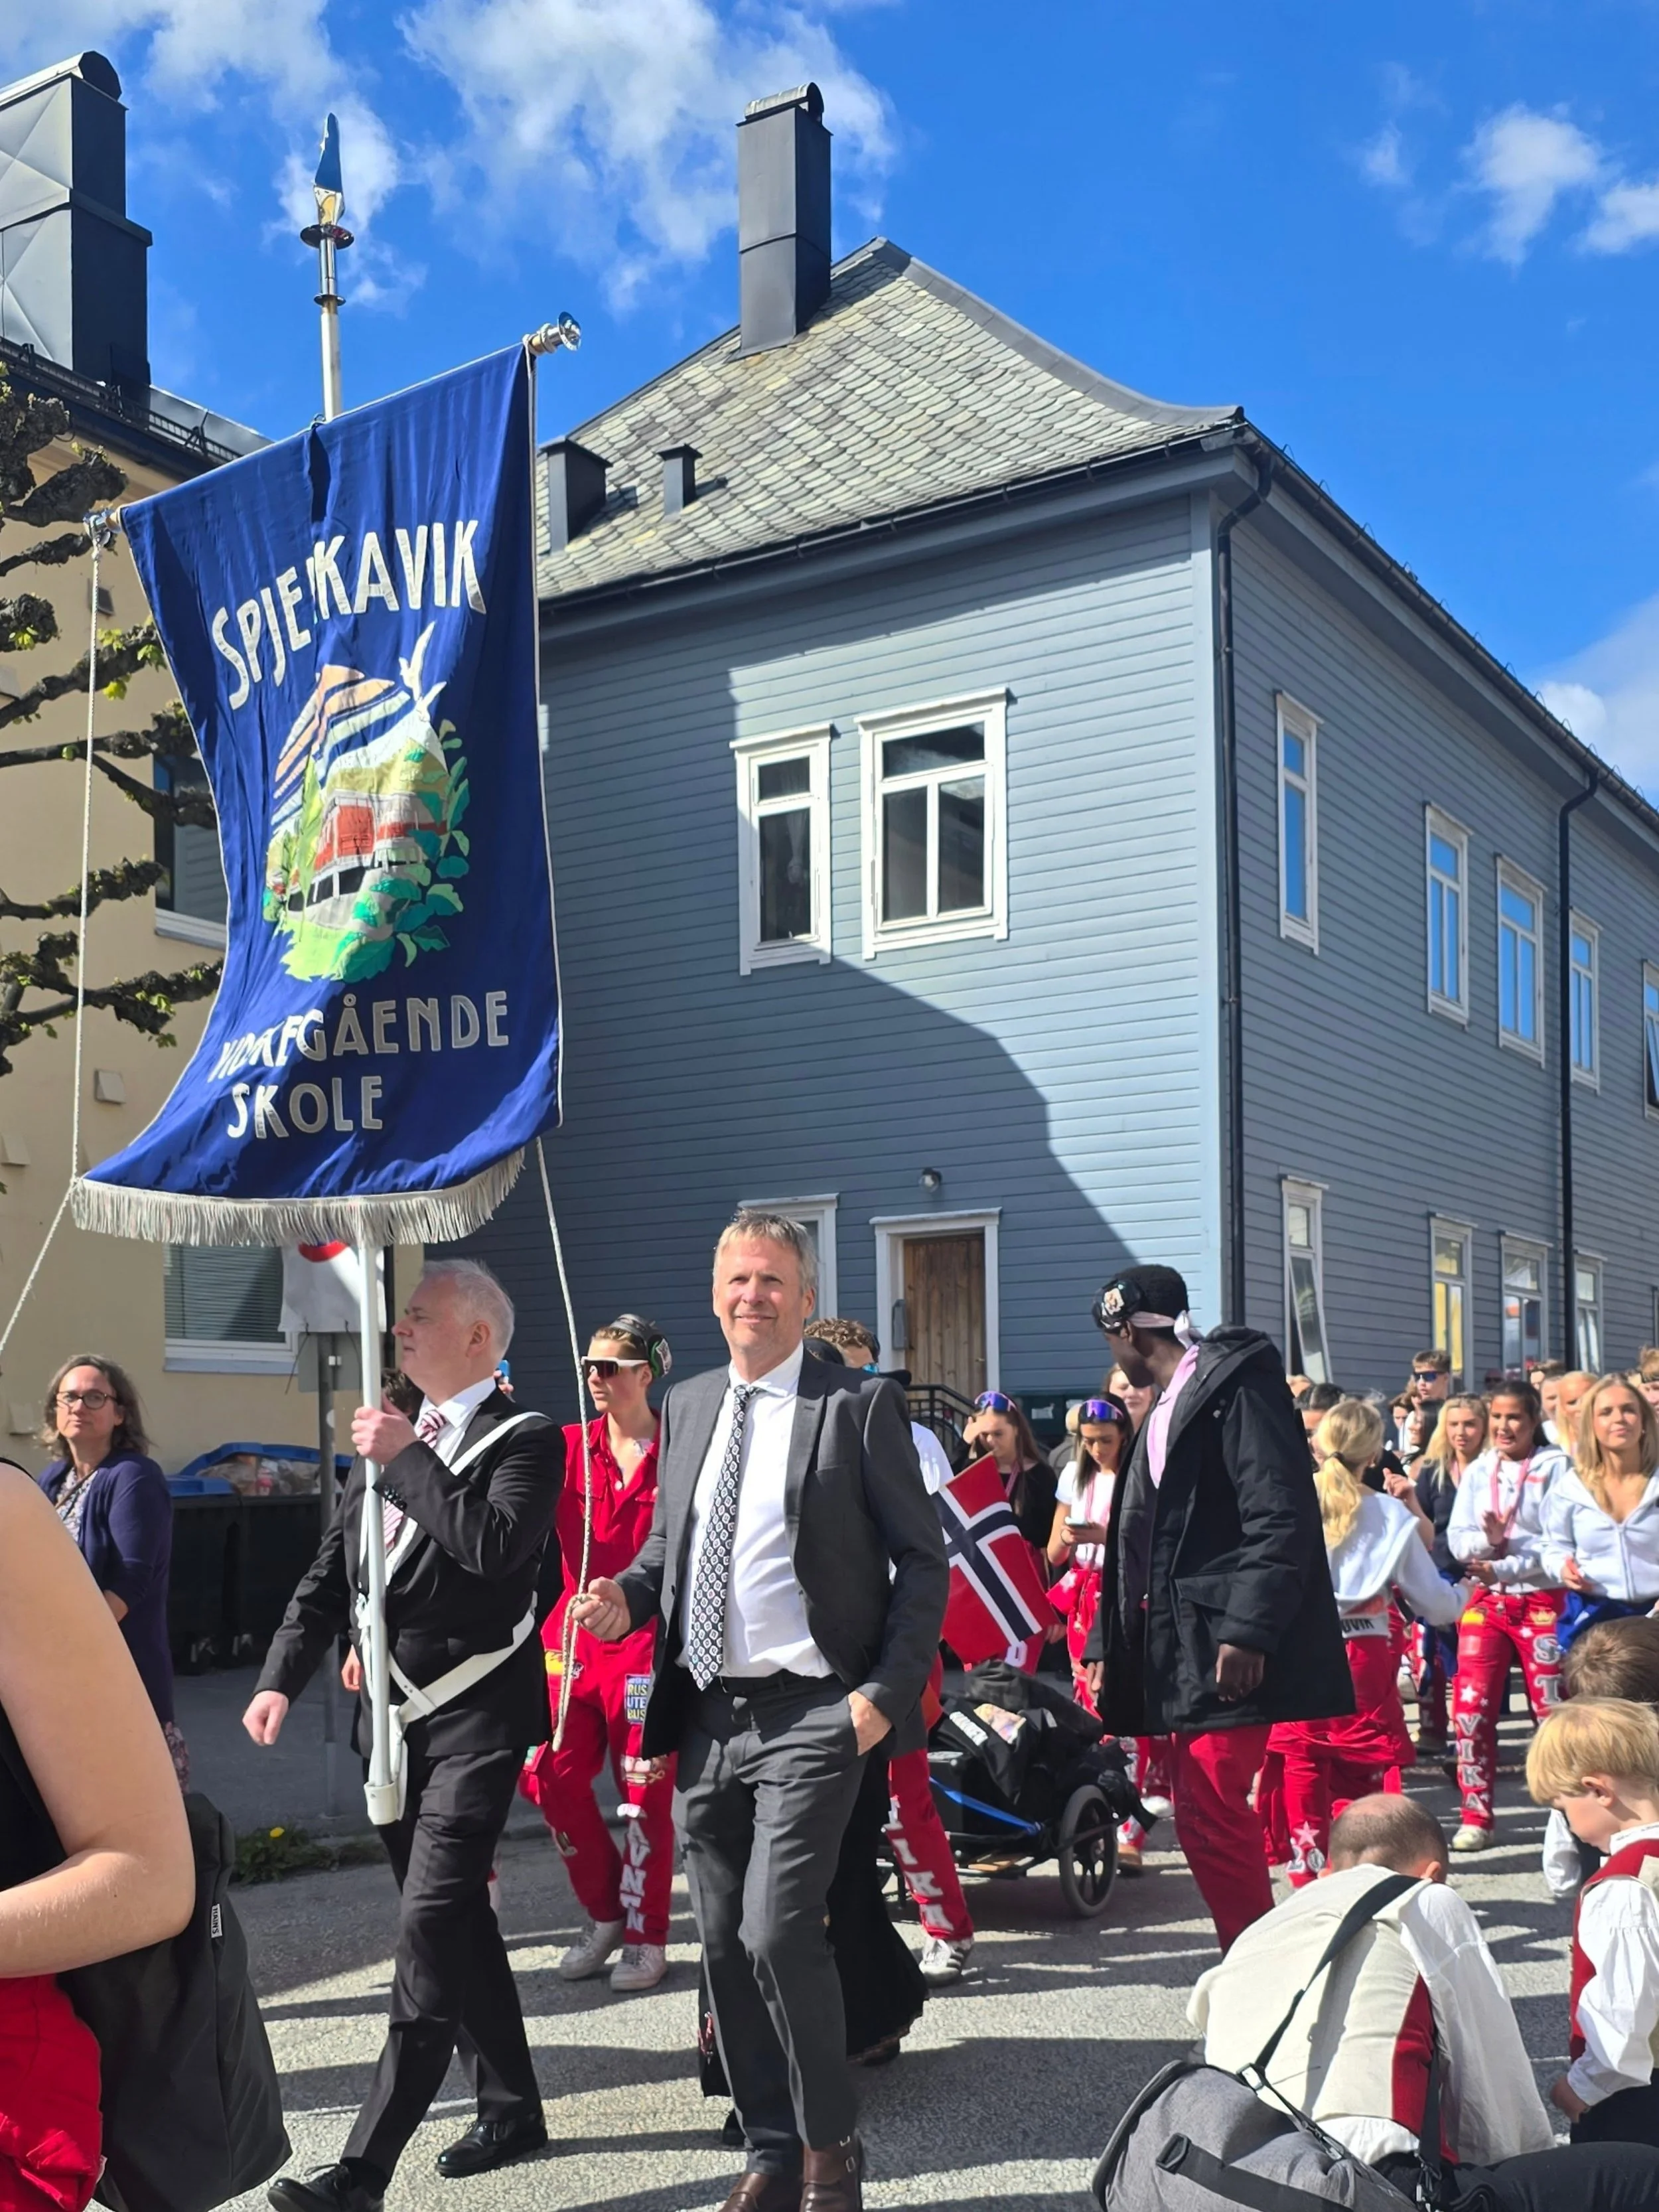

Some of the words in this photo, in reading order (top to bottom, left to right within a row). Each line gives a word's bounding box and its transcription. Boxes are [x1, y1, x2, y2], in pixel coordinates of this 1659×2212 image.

[227, 1075, 383, 1139] SKOLE
[627, 1684, 648, 1696] RUS
[626, 1696, 648, 1709] UTE
